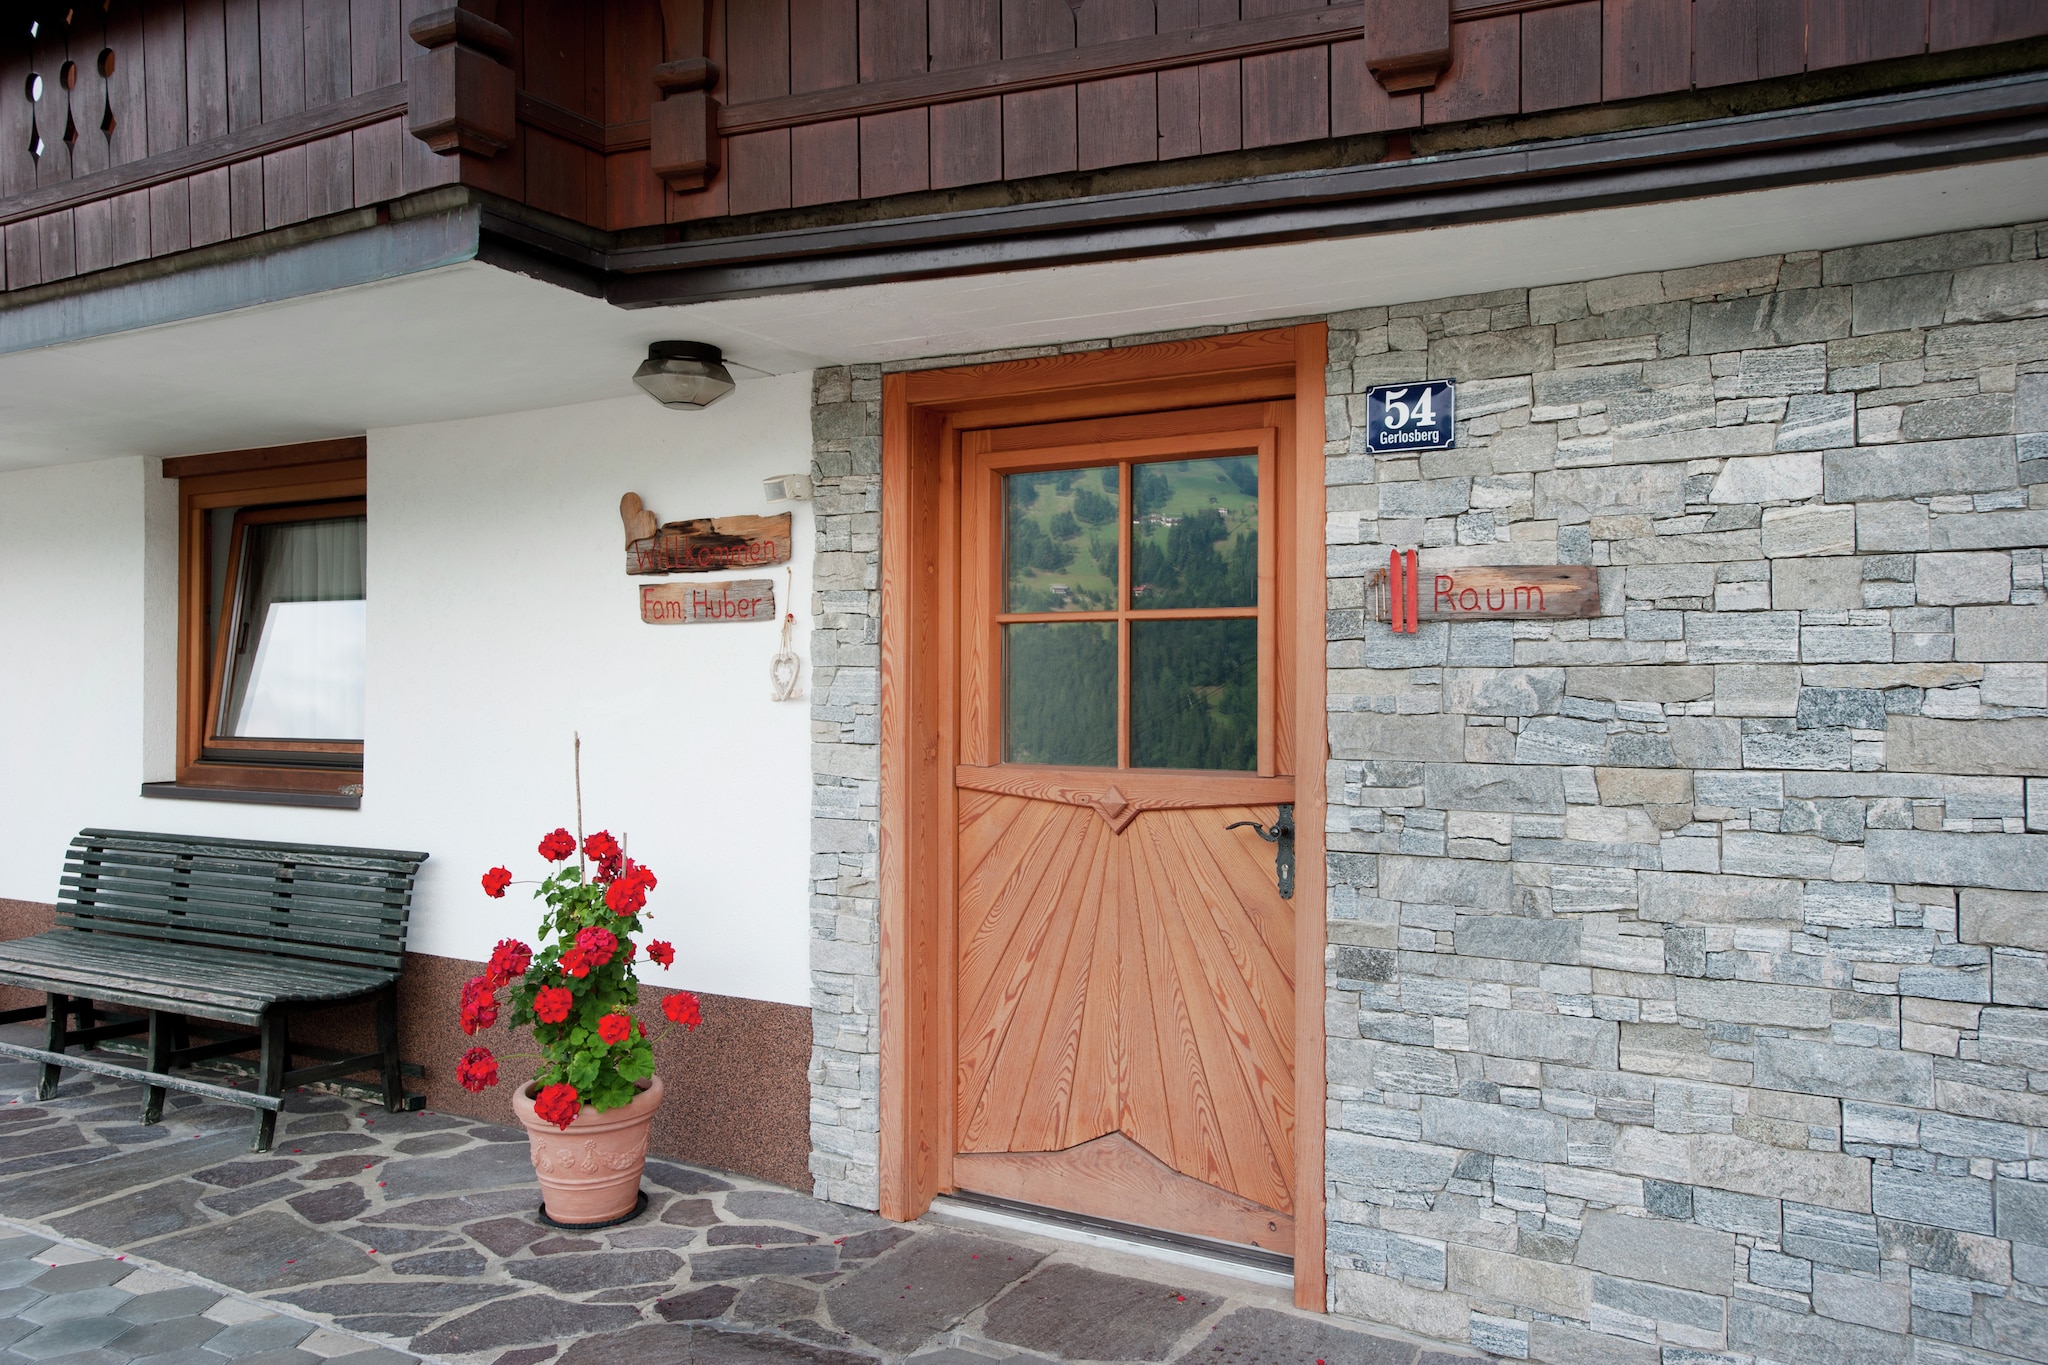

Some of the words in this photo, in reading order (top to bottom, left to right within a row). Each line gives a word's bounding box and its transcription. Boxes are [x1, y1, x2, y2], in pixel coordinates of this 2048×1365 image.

[1384, 387, 1436, 429] 54
[1380, 429, 1439, 444] Gerlosberg
[635, 536, 776, 570] Willkommen
[643, 588, 687, 619] Fam.
[693, 588, 762, 618] Huber
[1434, 575, 1546, 612] Raum
